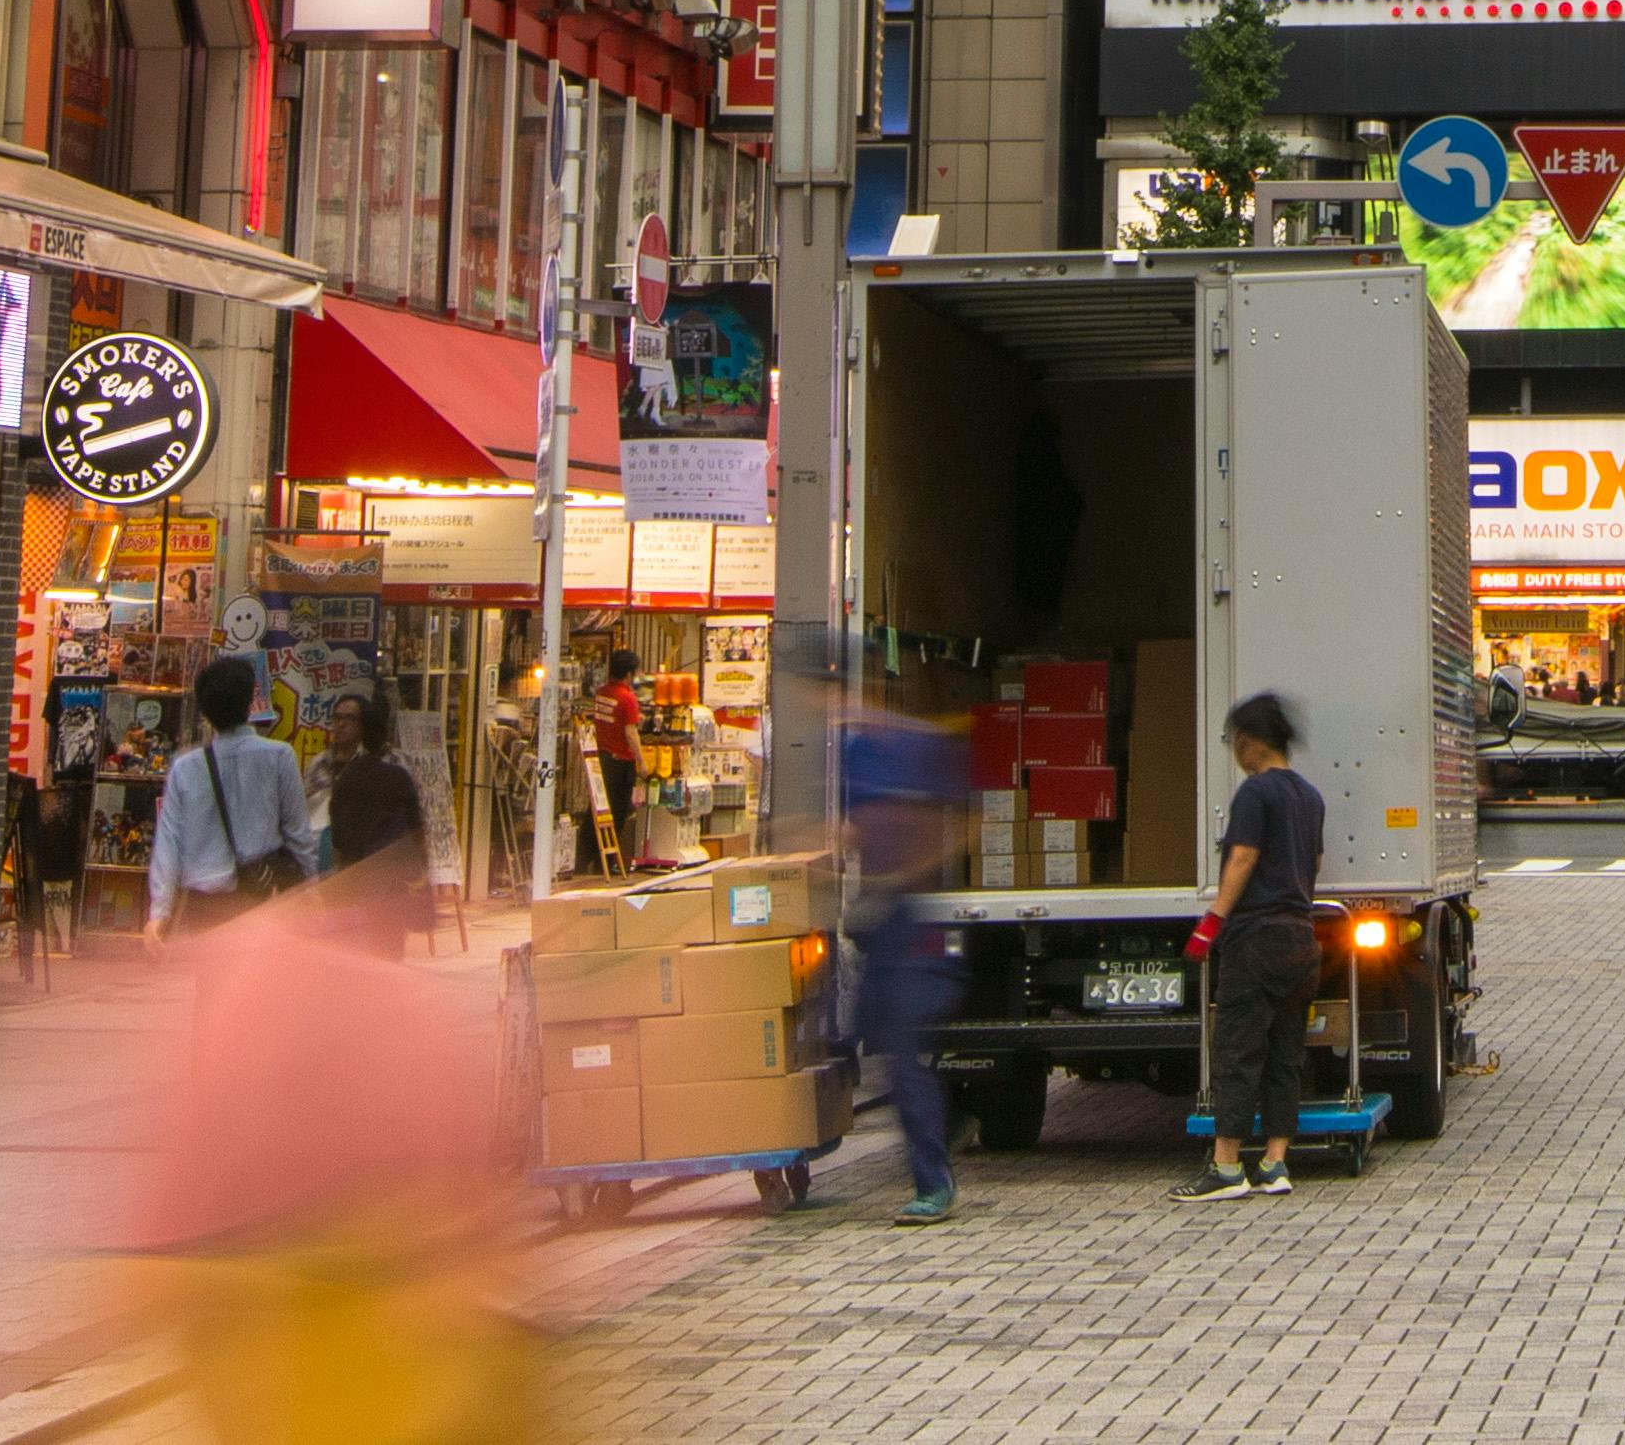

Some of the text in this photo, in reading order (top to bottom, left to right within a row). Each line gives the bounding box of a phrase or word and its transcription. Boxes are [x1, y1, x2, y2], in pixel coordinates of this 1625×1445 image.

[1540, 146, 1620, 175] 止まれ
[44, 225, 86, 262] ESPACE
[56, 339, 196, 402] SMOKER'S
[98, 371, 154, 404] Cafe
[56, 434, 188, 494] VAPE STAND
[627, 459, 690, 472] WONDER
[696, 460, 743, 471] QUEST
[689, 472, 704, 483] ON
[706, 472, 731, 483] SALE
[1523, 522, 1576, 539] MAIN
[1524, 572, 1563, 587] DUTY
[1565, 572, 1602, 587] FREE
[1108, 962, 1137, 976] 足立
[1106, 976, 1180, 1005] 36-36
